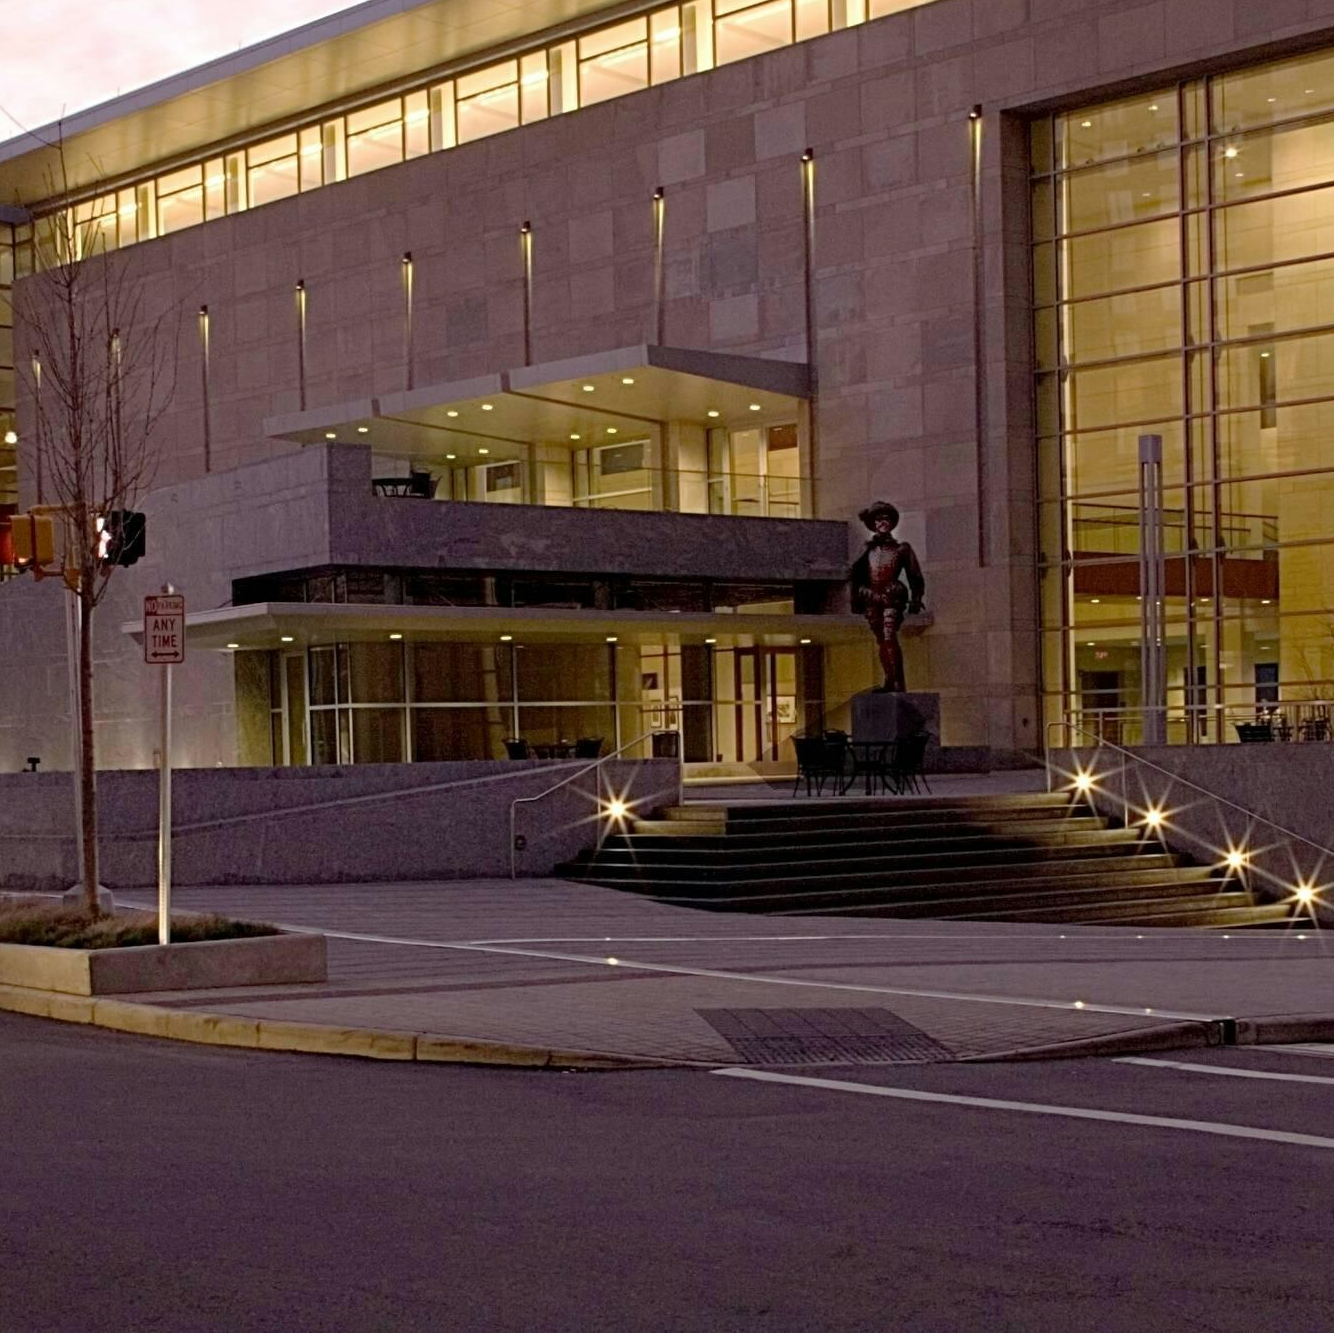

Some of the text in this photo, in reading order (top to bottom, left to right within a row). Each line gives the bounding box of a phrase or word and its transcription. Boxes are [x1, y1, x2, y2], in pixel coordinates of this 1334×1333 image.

[146, 601, 157, 612] NO
[153, 619, 176, 631] ANY
[152, 634, 177, 647] TIME
